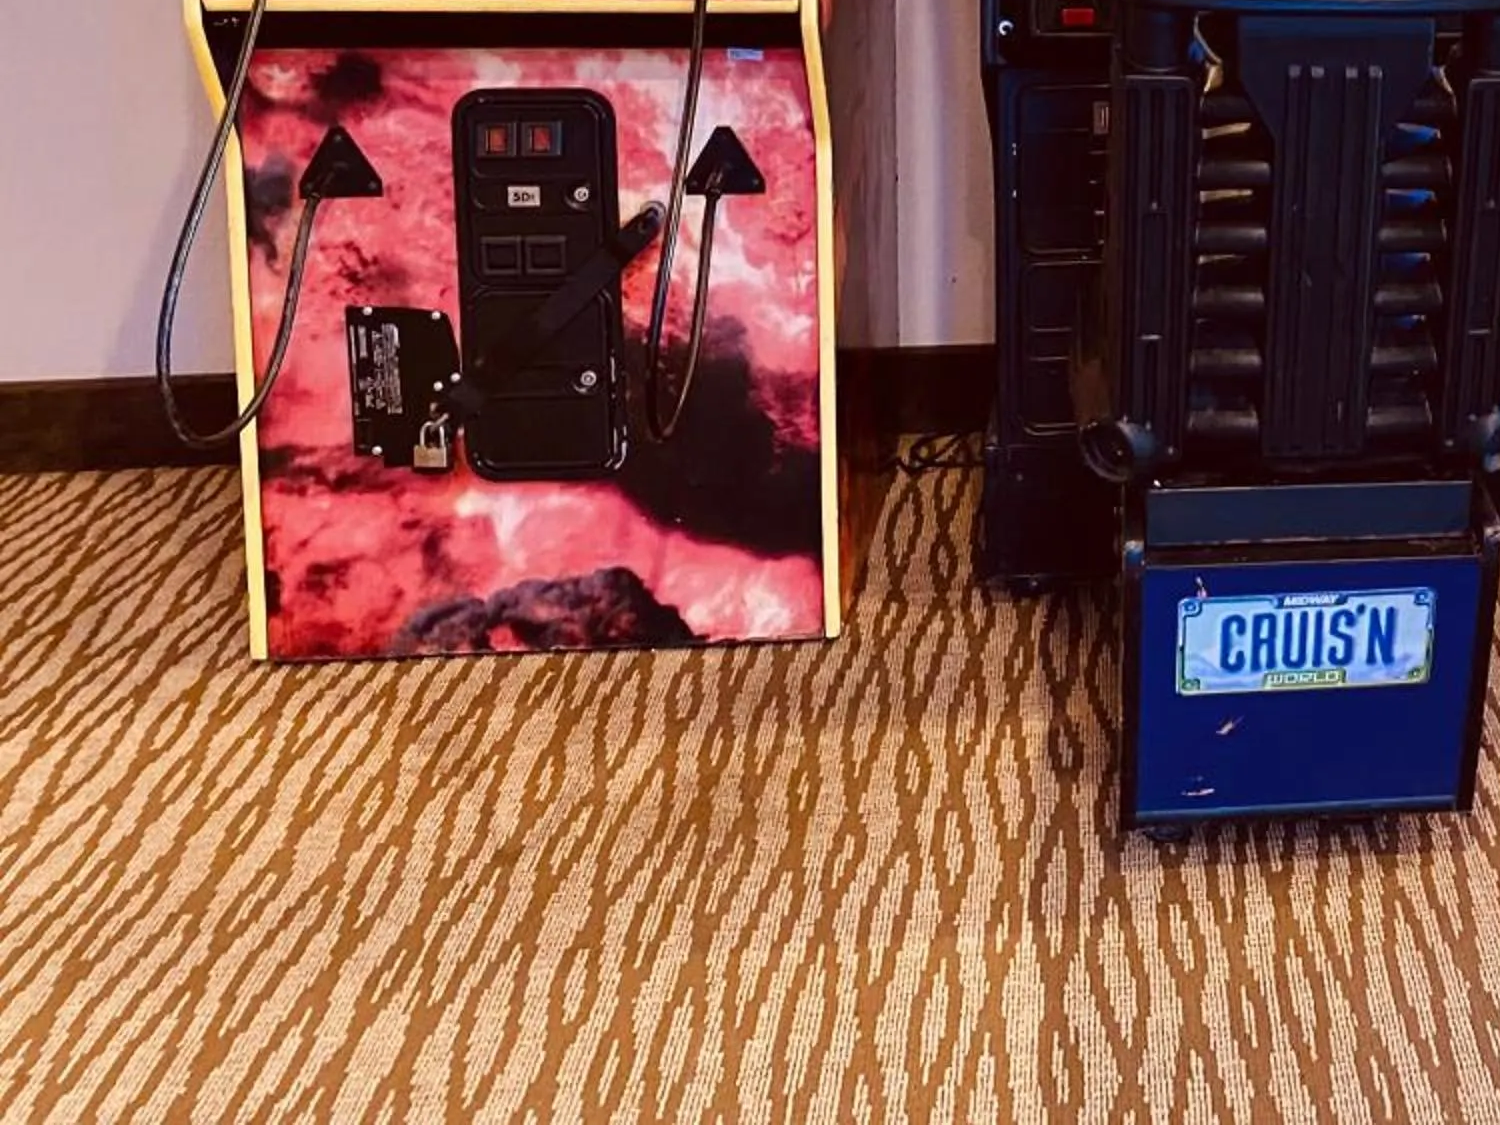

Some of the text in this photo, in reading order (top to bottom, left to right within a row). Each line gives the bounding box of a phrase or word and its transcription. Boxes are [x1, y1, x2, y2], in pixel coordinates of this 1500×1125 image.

[1283, 595, 1340, 606] MIDWAY
[1219, 604, 1396, 673] CRUIS'N
[1267, 670, 1341, 684] WORLD
